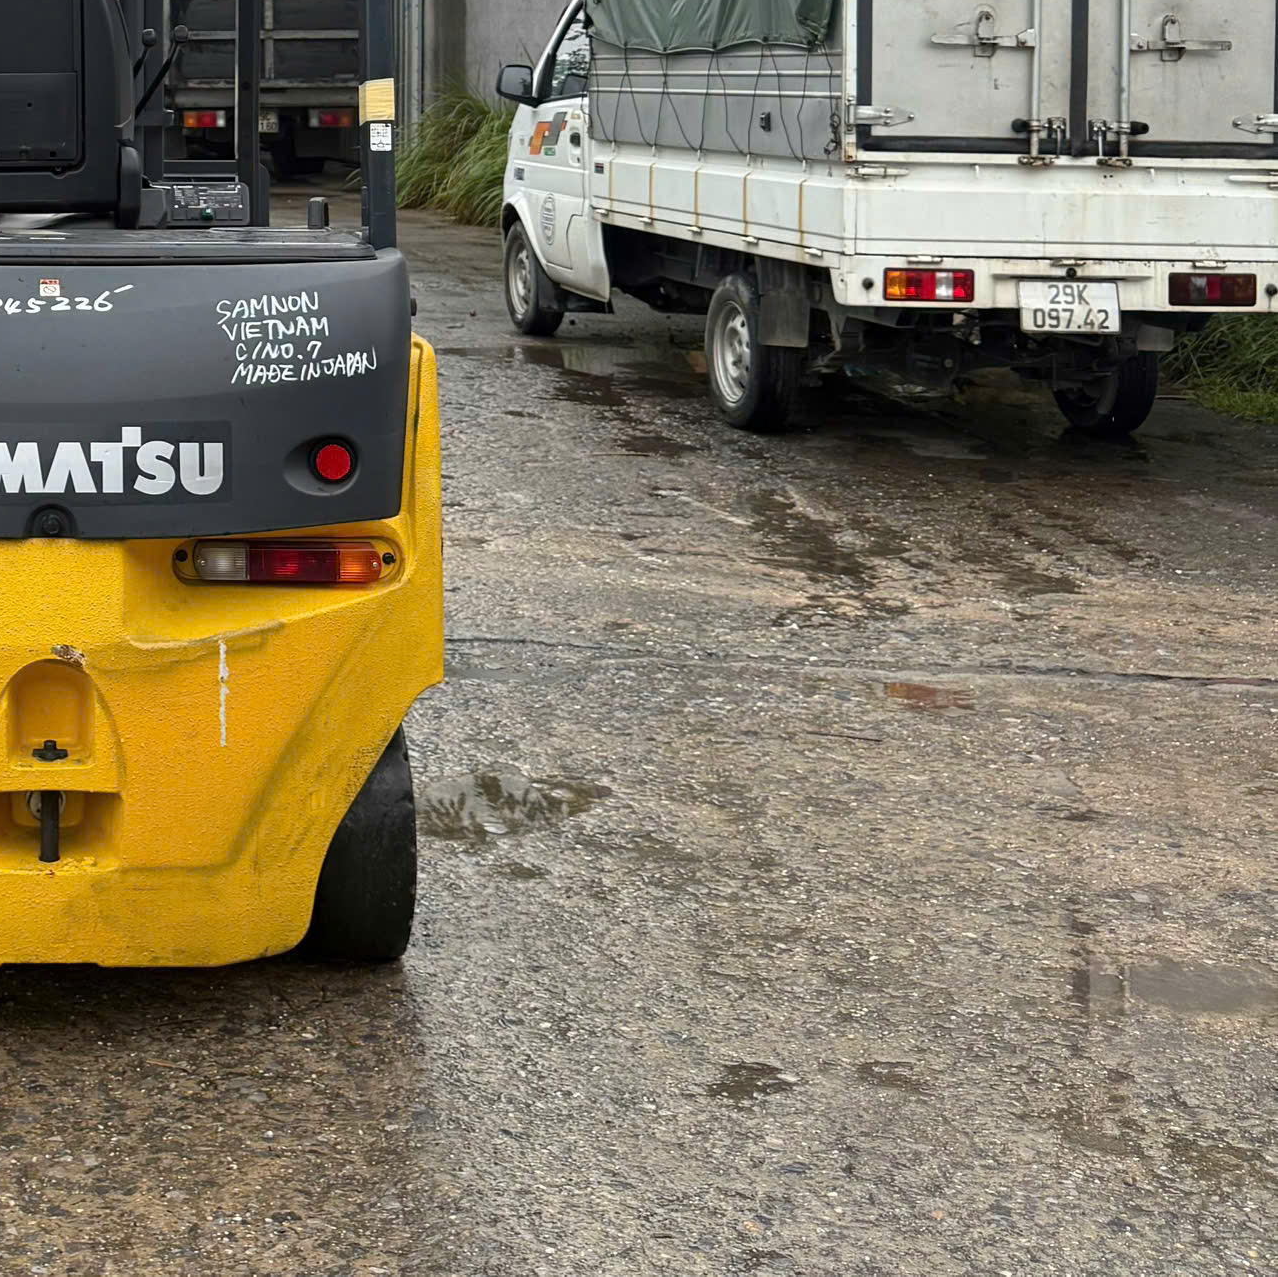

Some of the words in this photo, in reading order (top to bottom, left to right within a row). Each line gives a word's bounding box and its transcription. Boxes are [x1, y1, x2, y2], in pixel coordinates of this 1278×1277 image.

[1047, 284, 1091, 306] 29K
[216, 291, 319, 325] SAMNON
[1033, 308, 1110, 330] 097.42
[221, 316, 330, 342] VIETNAM
[230, 362, 299, 385] MADE
